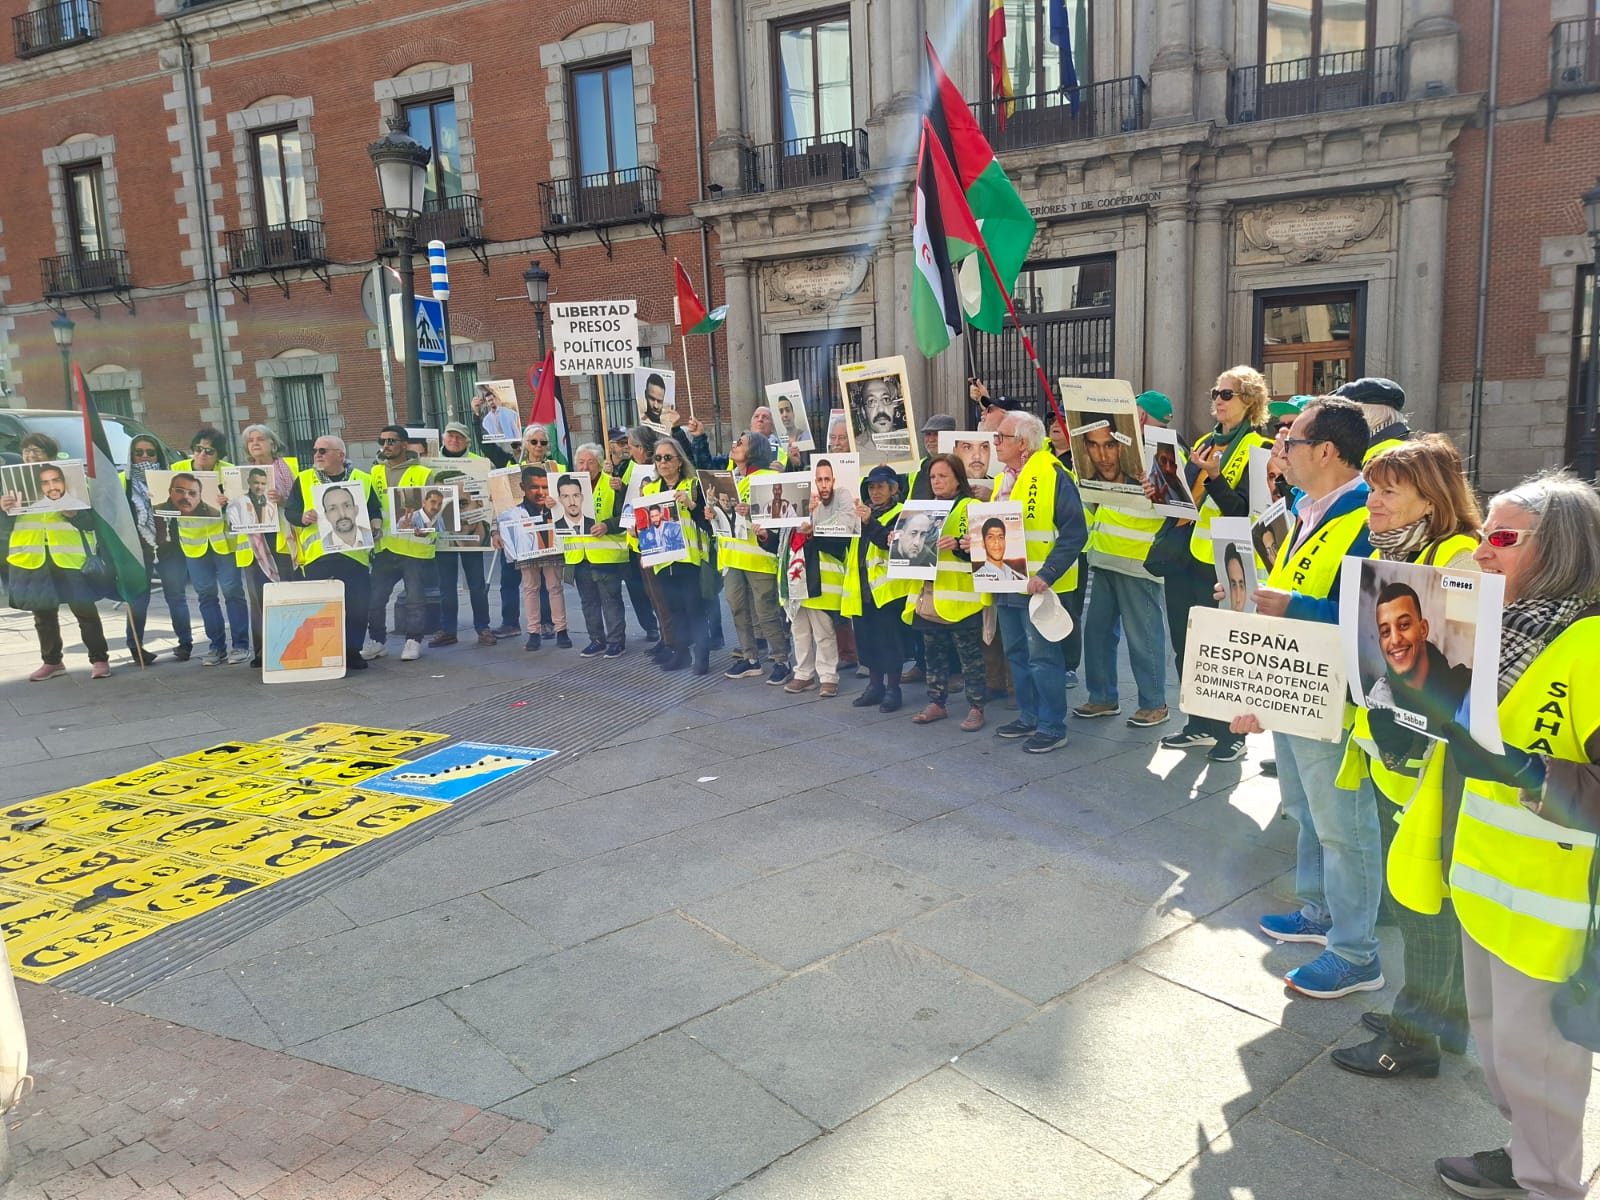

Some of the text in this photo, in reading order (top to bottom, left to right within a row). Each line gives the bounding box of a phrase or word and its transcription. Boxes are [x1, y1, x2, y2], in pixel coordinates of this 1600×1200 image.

[1029, 202, 1067, 216] ERIORES
[1071, 203, 1077, 212] Y
[1081, 201, 1094, 210] DE
[556, 304, 630, 318] LIBERTAD
[569, 319, 621, 333] PRESOS
[563, 338, 633, 353] POLÍTICOS
[559, 357, 634, 371] SAHARAUIS
[1026, 476, 1038, 519] SAHARA
[1292, 530, 1329, 590] LIBR
[1442, 576, 1473, 590] 6 meses
[1228, 629, 1300, 652] ESPAÑA
[1199, 644, 1329, 678] RESPONSABLE
[1195, 661, 1330, 693] POR SER LA POTENCIA
[1194, 674, 1328, 707] ADMINISTRADORA DEL
[1195, 686, 1324, 719] SAHARA OCCIDENTAL
[1403, 712, 1425, 727] Sabbar
